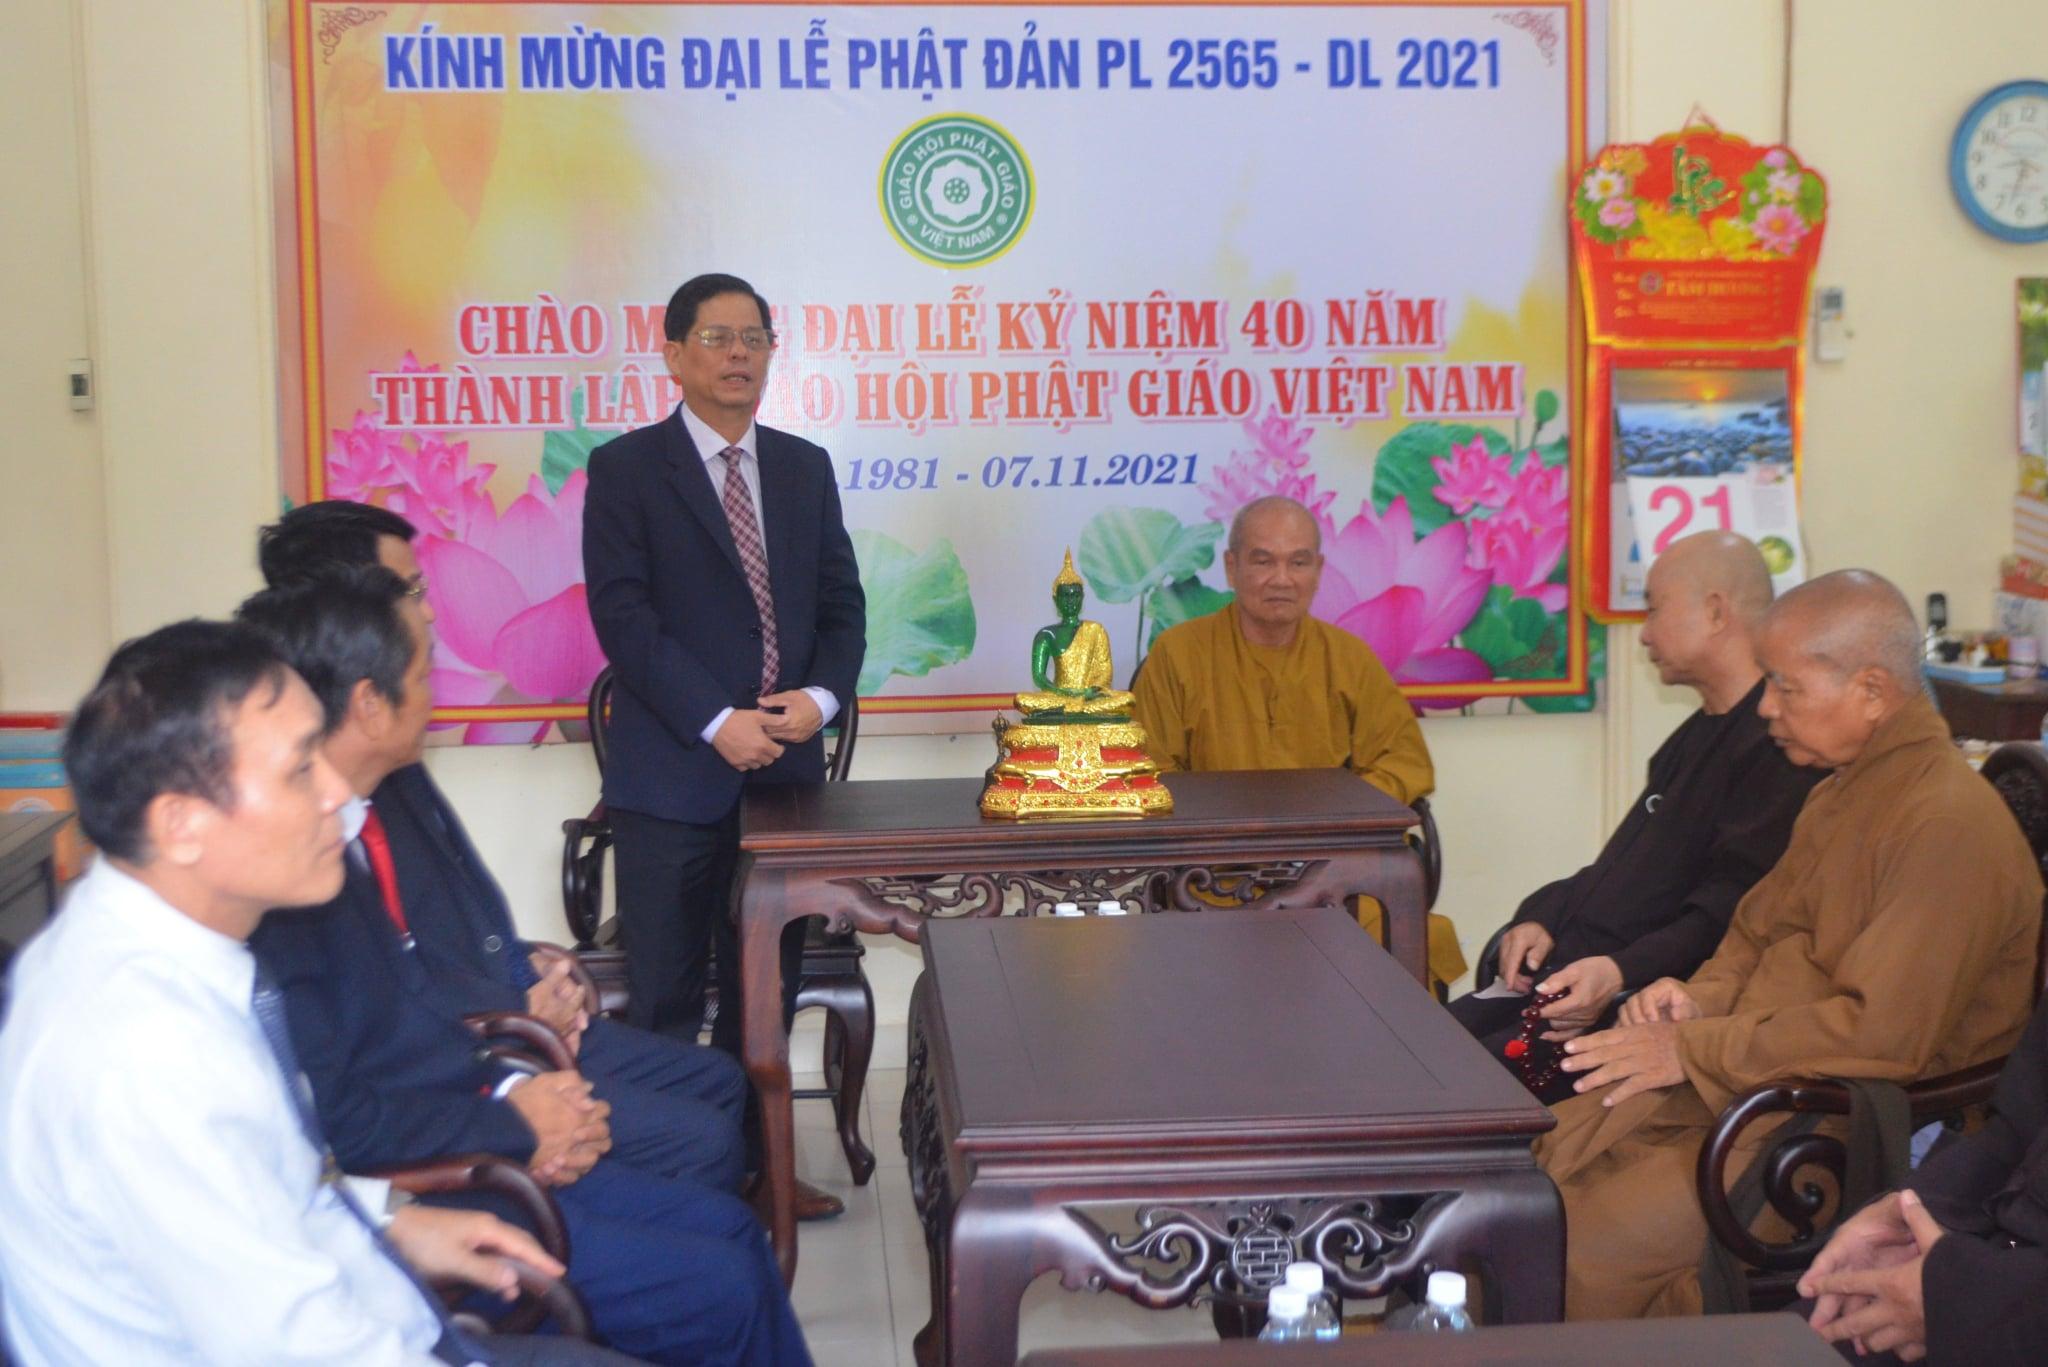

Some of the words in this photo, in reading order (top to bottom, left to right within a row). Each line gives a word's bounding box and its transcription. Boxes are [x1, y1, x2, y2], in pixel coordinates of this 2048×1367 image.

[386, 25, 504, 89] KÍNH
[521, 24, 667, 90] MỪNG
[680, 37, 762, 101] ĐẠI
[778, 18, 832, 89] LỄ
[848, 26, 968, 101] PHẬT
[983, 20, 1081, 89] ĐẢN
[1097, 37, 1154, 90] PL
[1167, 37, 1280, 89] 2565
[1327, 37, 1383, 89] DL
[1396, 38, 1501, 89] 2021
[896, 161, 917, 210] GIÁO
[996, 162, 1018, 209] GIÁO
[919, 224, 954, 249] VIỆT
[958, 225, 996, 249] NAM
[460, 295, 604, 355] CHÀO
[803, 304, 894, 360] ĐẠI
[915, 285, 976, 350] LỄ
[996, 288, 1066, 349] KỶ
[1086, 290, 1219, 357] NIỆM
[1241, 300, 1305, 348] 40
[1326, 289, 1436, 346] NĂM
[377, 365, 564, 425] THÀNH
[854, 362, 948, 429] HỘI
[969, 360, 1109, 427] PHẬT
[1127, 358, 1252, 416] GIÁO
[1270, 356, 1387, 422] VIỆT
[1405, 365, 1515, 412] NAM
[981, 453, 1198, 489] 07.11.2021
[1649, 485, 1733, 556] 21
